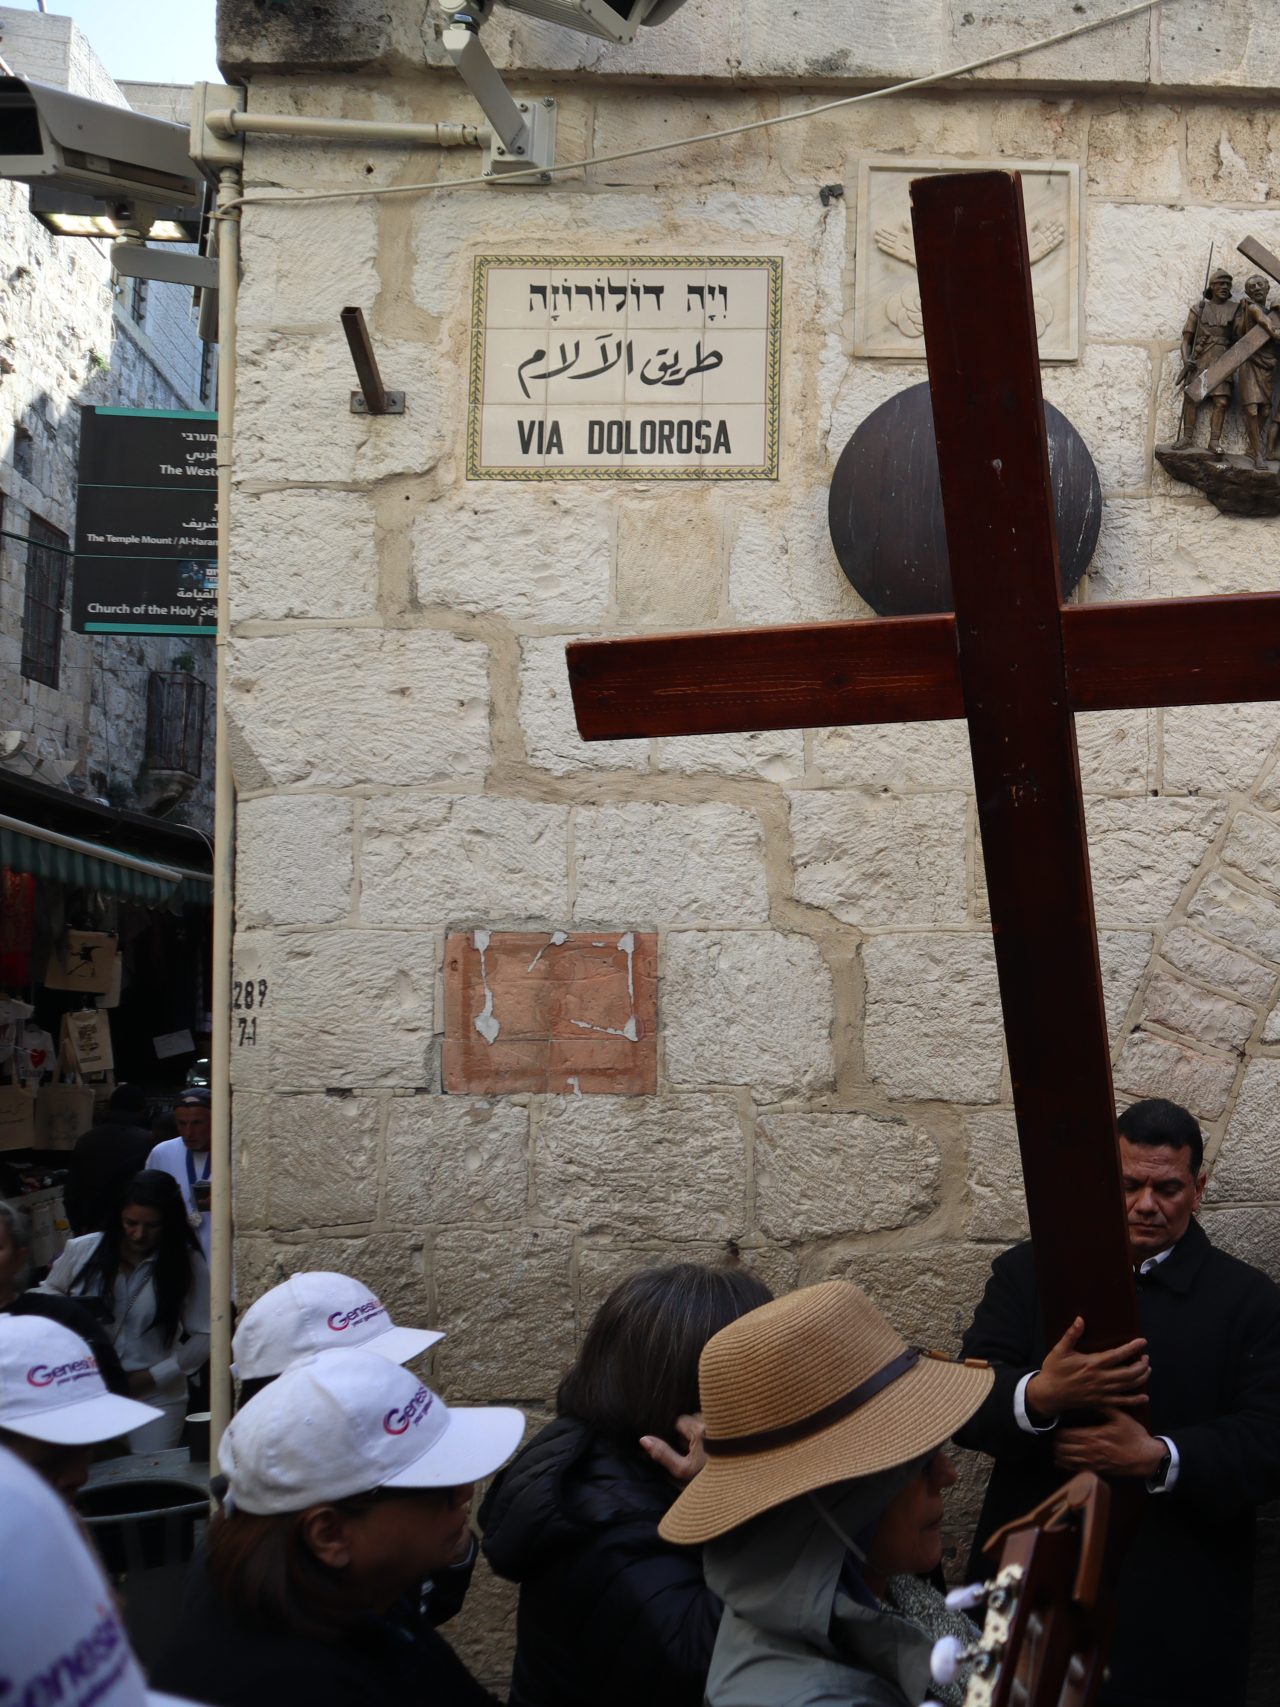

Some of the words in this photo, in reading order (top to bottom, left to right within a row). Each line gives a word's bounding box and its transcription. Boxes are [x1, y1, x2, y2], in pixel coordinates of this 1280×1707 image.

[640, 340, 724, 386] طريق
[517, 419, 564, 455] VIA
[587, 419, 732, 455] DOLOROSA
[159, 464, 184, 475] The
[86, 533, 105, 543] The
[105, 534, 140, 545] Temple
[141, 535, 173, 545] Mount
[87, 603, 130, 614] Church
[132, 604, 147, 615] of
[147, 605, 168, 615] the
[170, 605, 198, 619] Holy
[233, 979, 268, 1010] 289
